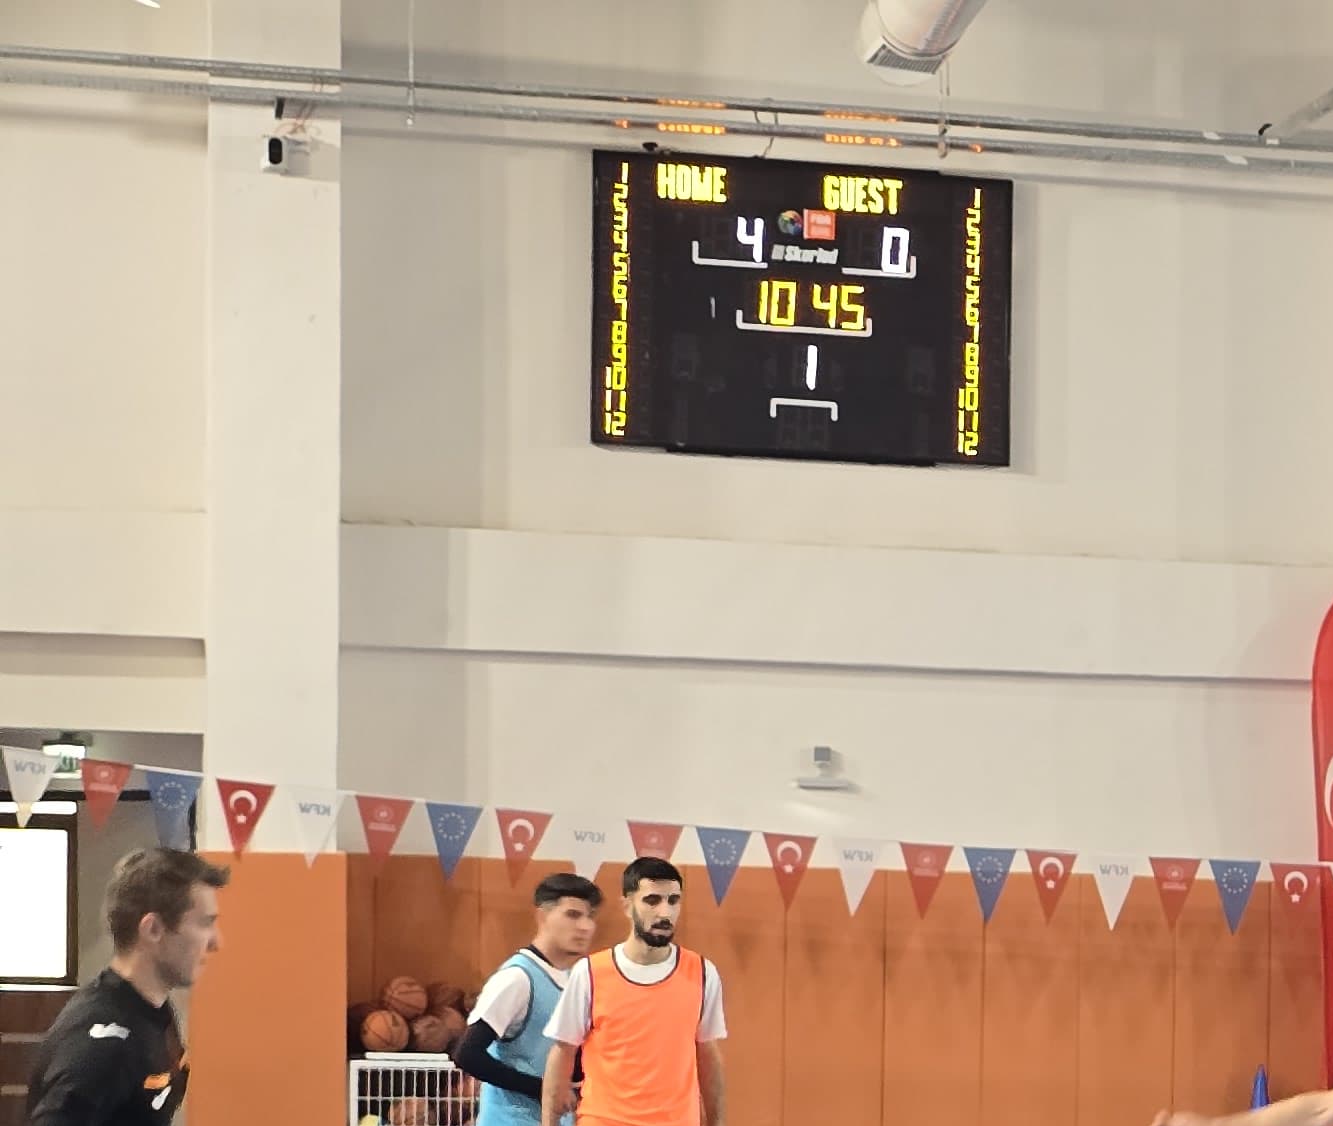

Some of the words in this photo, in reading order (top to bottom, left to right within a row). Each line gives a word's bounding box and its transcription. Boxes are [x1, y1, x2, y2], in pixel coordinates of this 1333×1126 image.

[657, 163, 727, 202] HOME
[823, 175, 903, 215] GUEST
[736, 216, 765, 263] 4
[881, 226, 910, 274] 0
[758, 280, 797, 326] 10
[812, 284, 865, 330] 45
